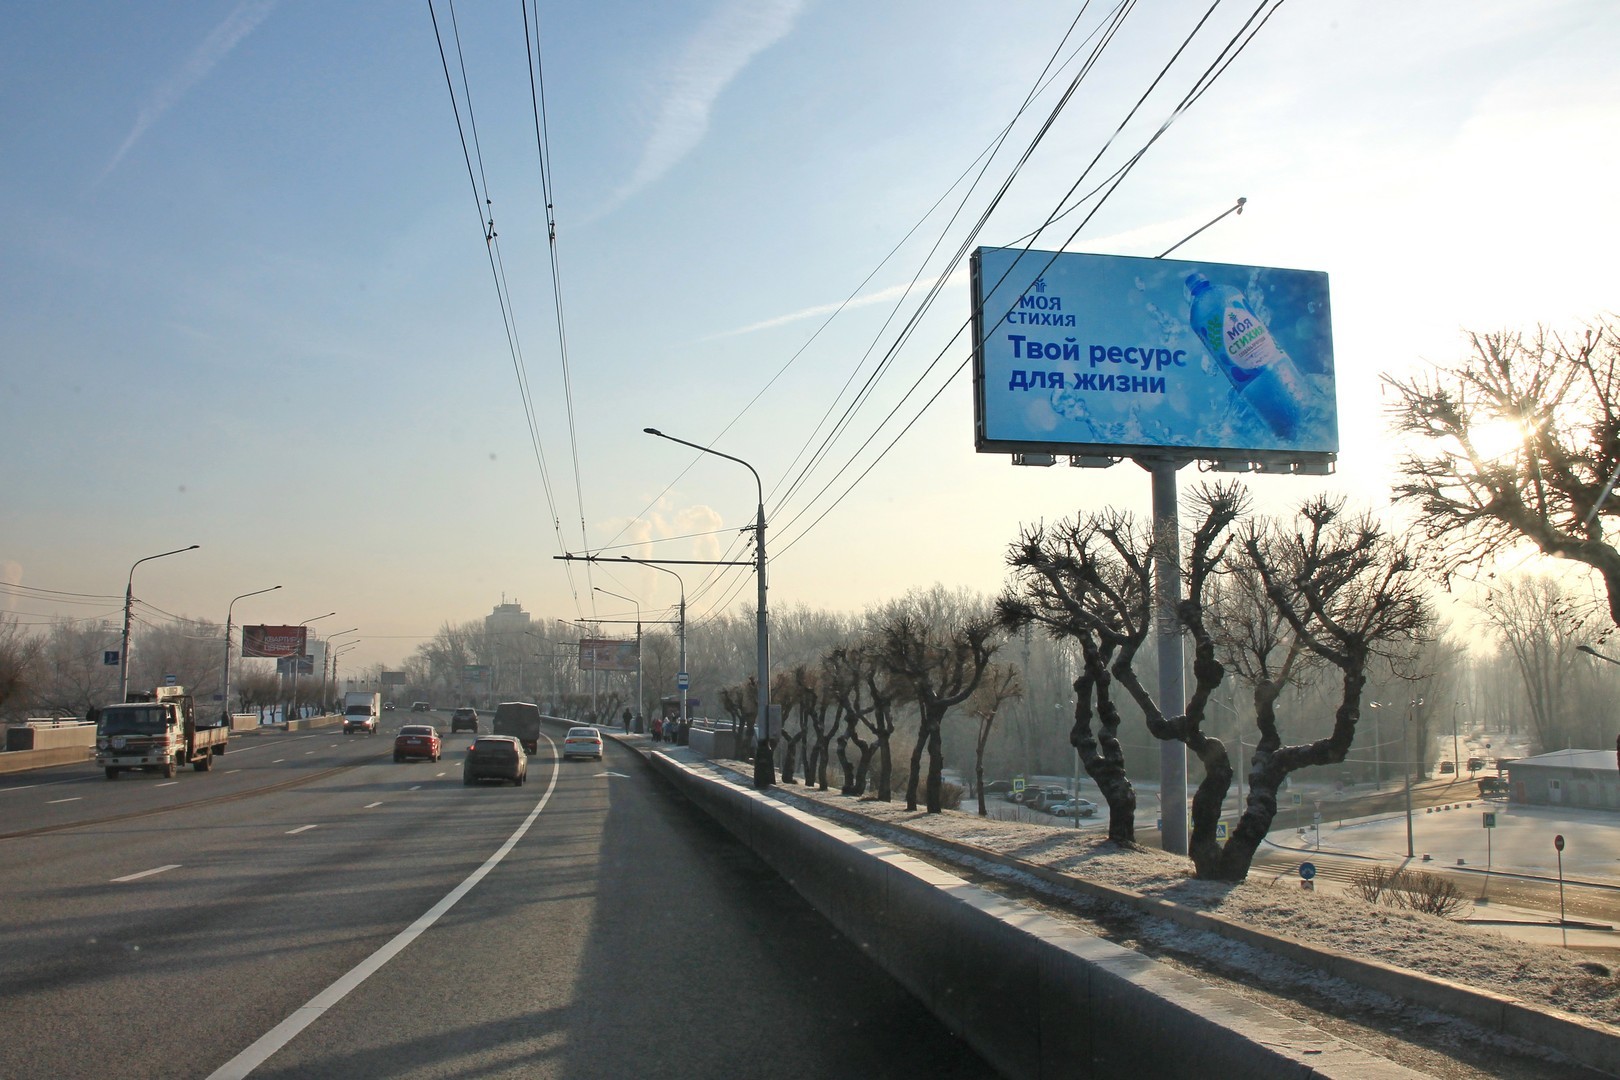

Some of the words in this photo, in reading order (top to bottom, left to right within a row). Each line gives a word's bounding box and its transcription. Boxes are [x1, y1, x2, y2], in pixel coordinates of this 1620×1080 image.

[1020, 295, 1061, 311] МОЯ
[1007, 312, 1076, 327] СТИХИЯ
[1227, 318, 1253, 341] МОЯ
[1228, 325, 1265, 355] СТИХИЯ
[1008, 334, 1080, 362] Твой
[1089, 344, 1187, 371] ресурс
[1009, 370, 1065, 392] для
[1073, 373, 1166, 394] жизни
